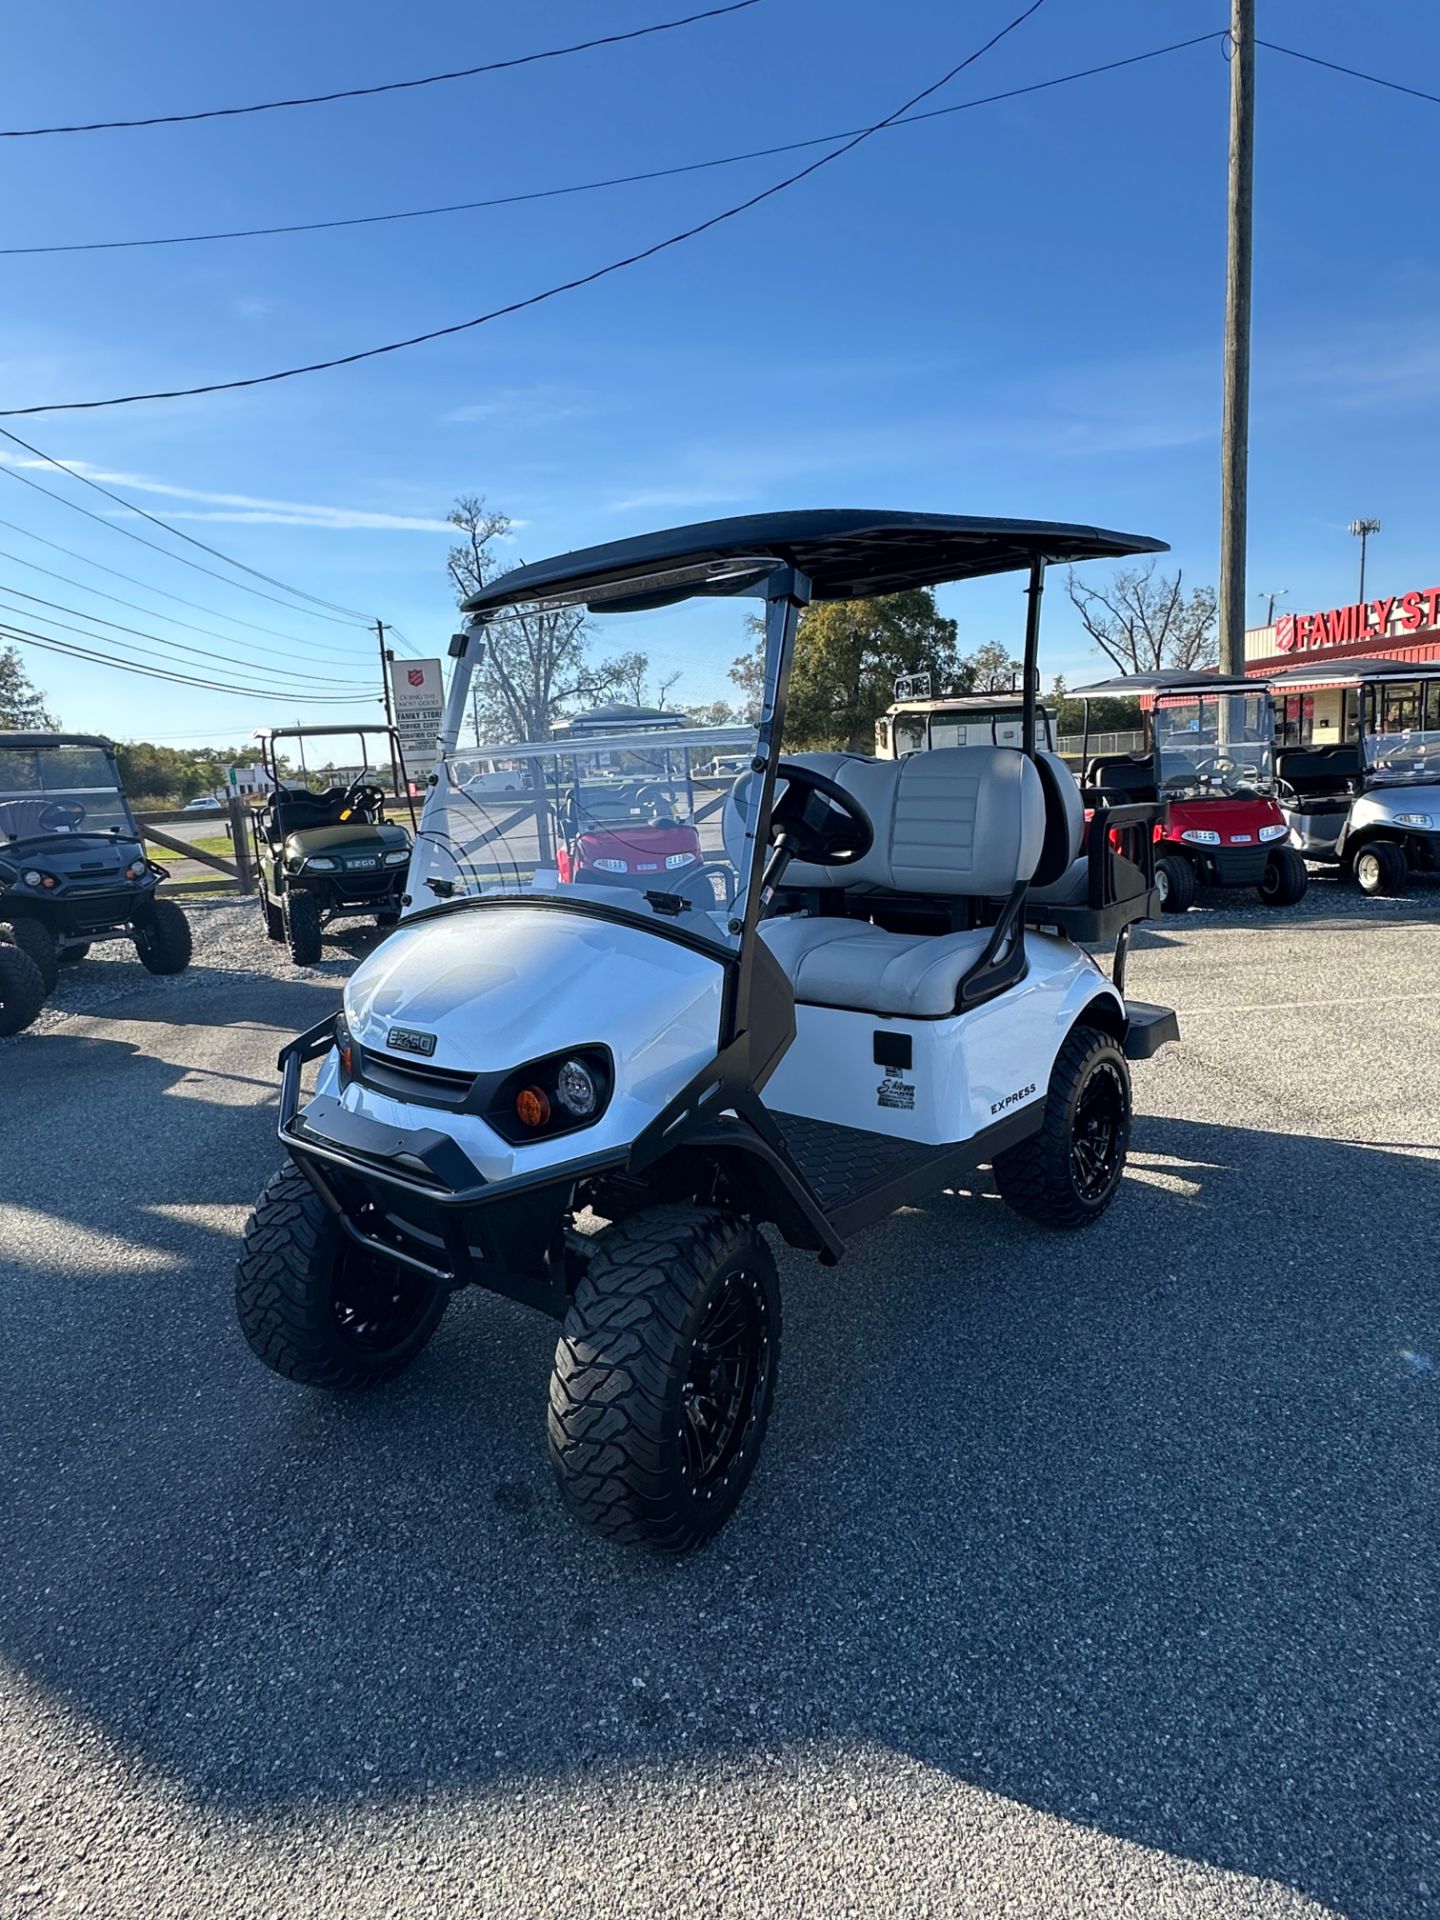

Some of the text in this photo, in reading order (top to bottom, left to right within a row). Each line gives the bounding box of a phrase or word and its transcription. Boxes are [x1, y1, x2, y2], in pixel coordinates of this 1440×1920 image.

[1296, 597, 1396, 649] FAMILY
[397, 712, 420, 720] FAMILY
[991, 1083, 1036, 1115] EXPRESS
